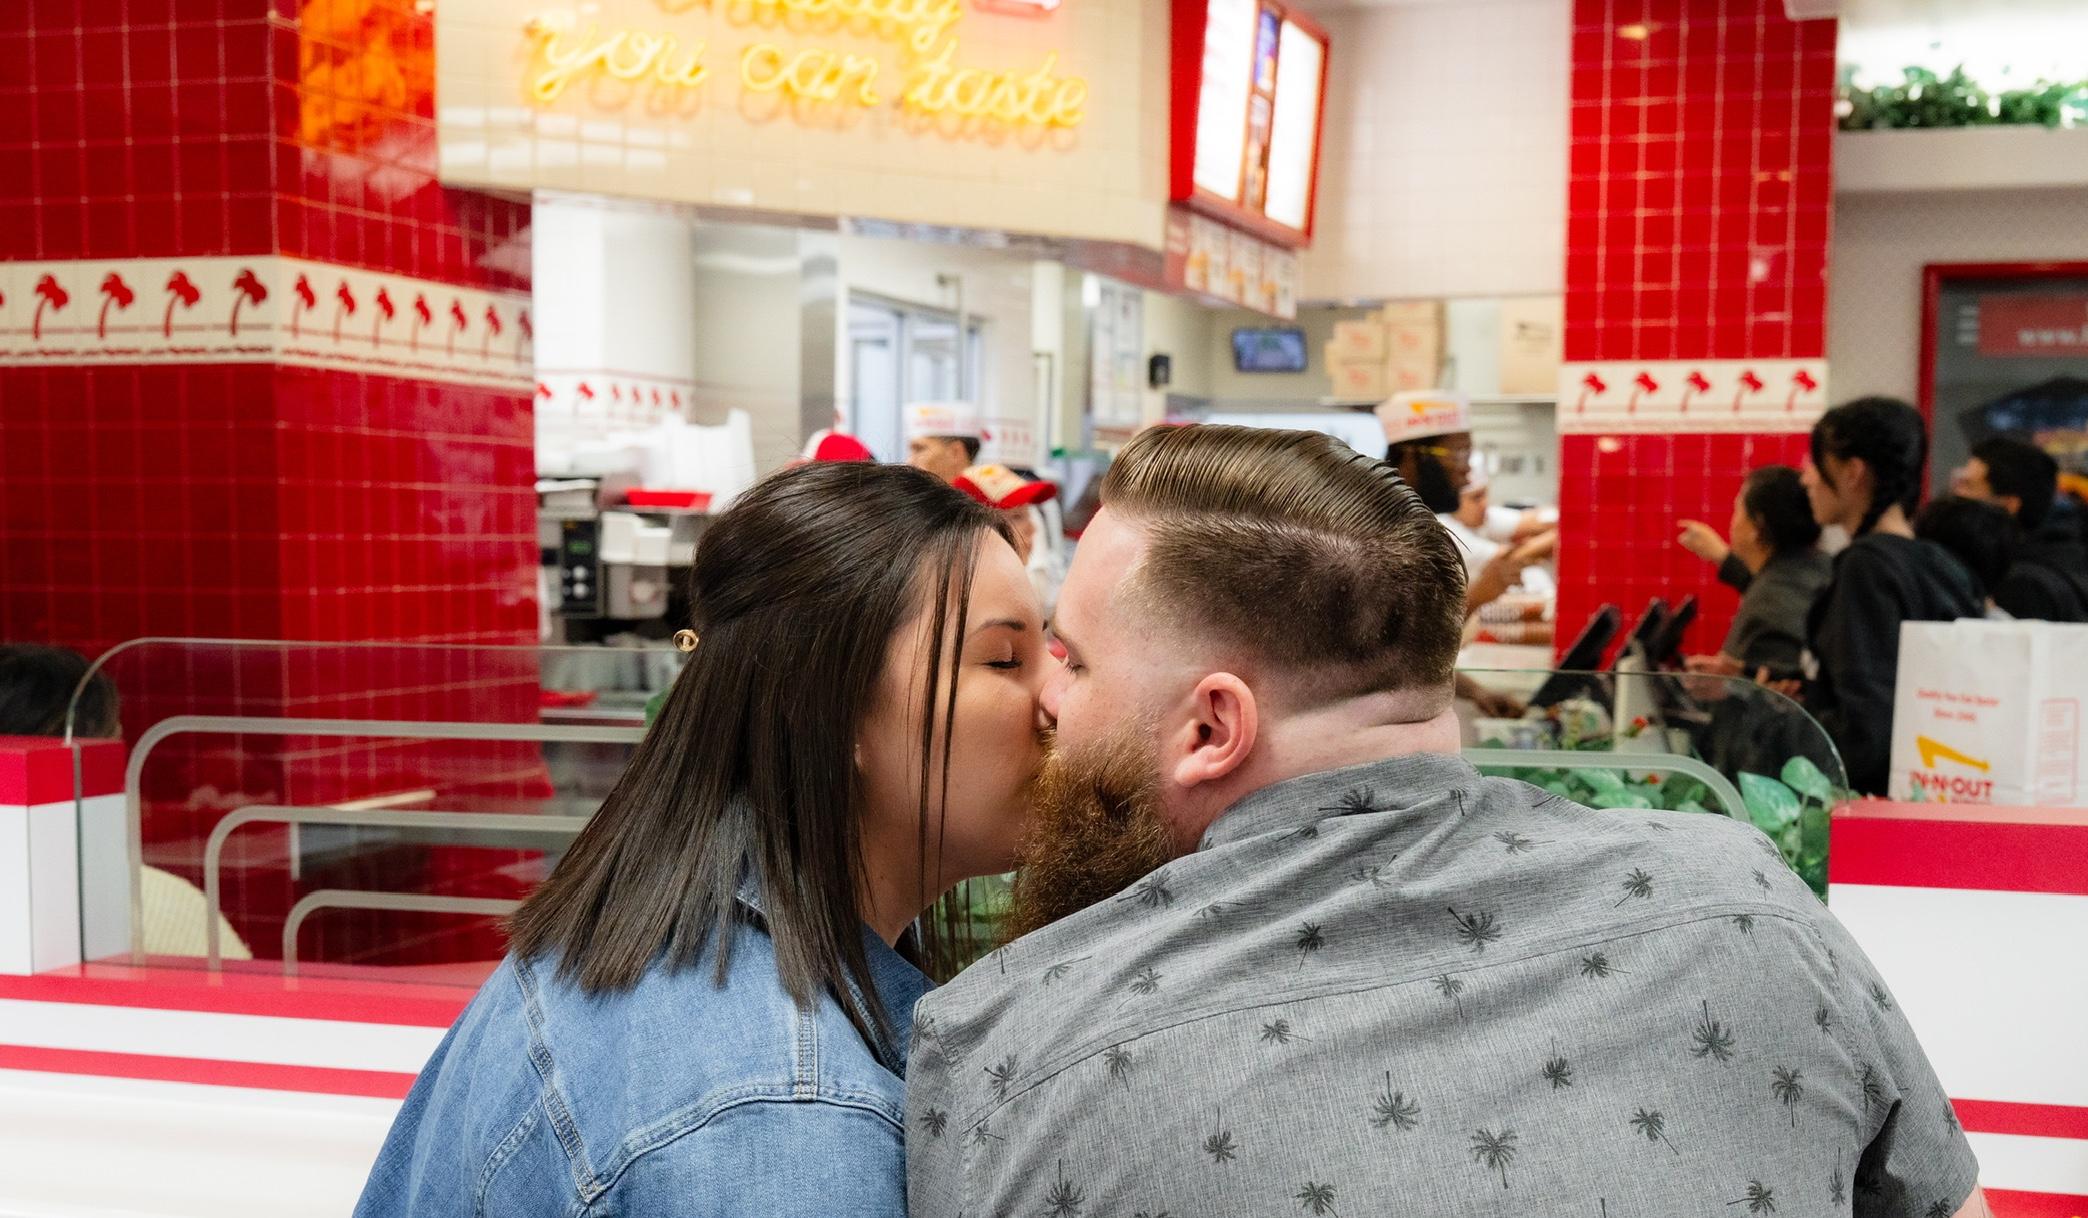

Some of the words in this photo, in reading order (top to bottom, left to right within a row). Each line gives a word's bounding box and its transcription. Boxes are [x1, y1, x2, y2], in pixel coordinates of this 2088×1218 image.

[533, 24, 708, 101] you
[741, 43, 880, 106] can
[907, 38, 1086, 126] taste
